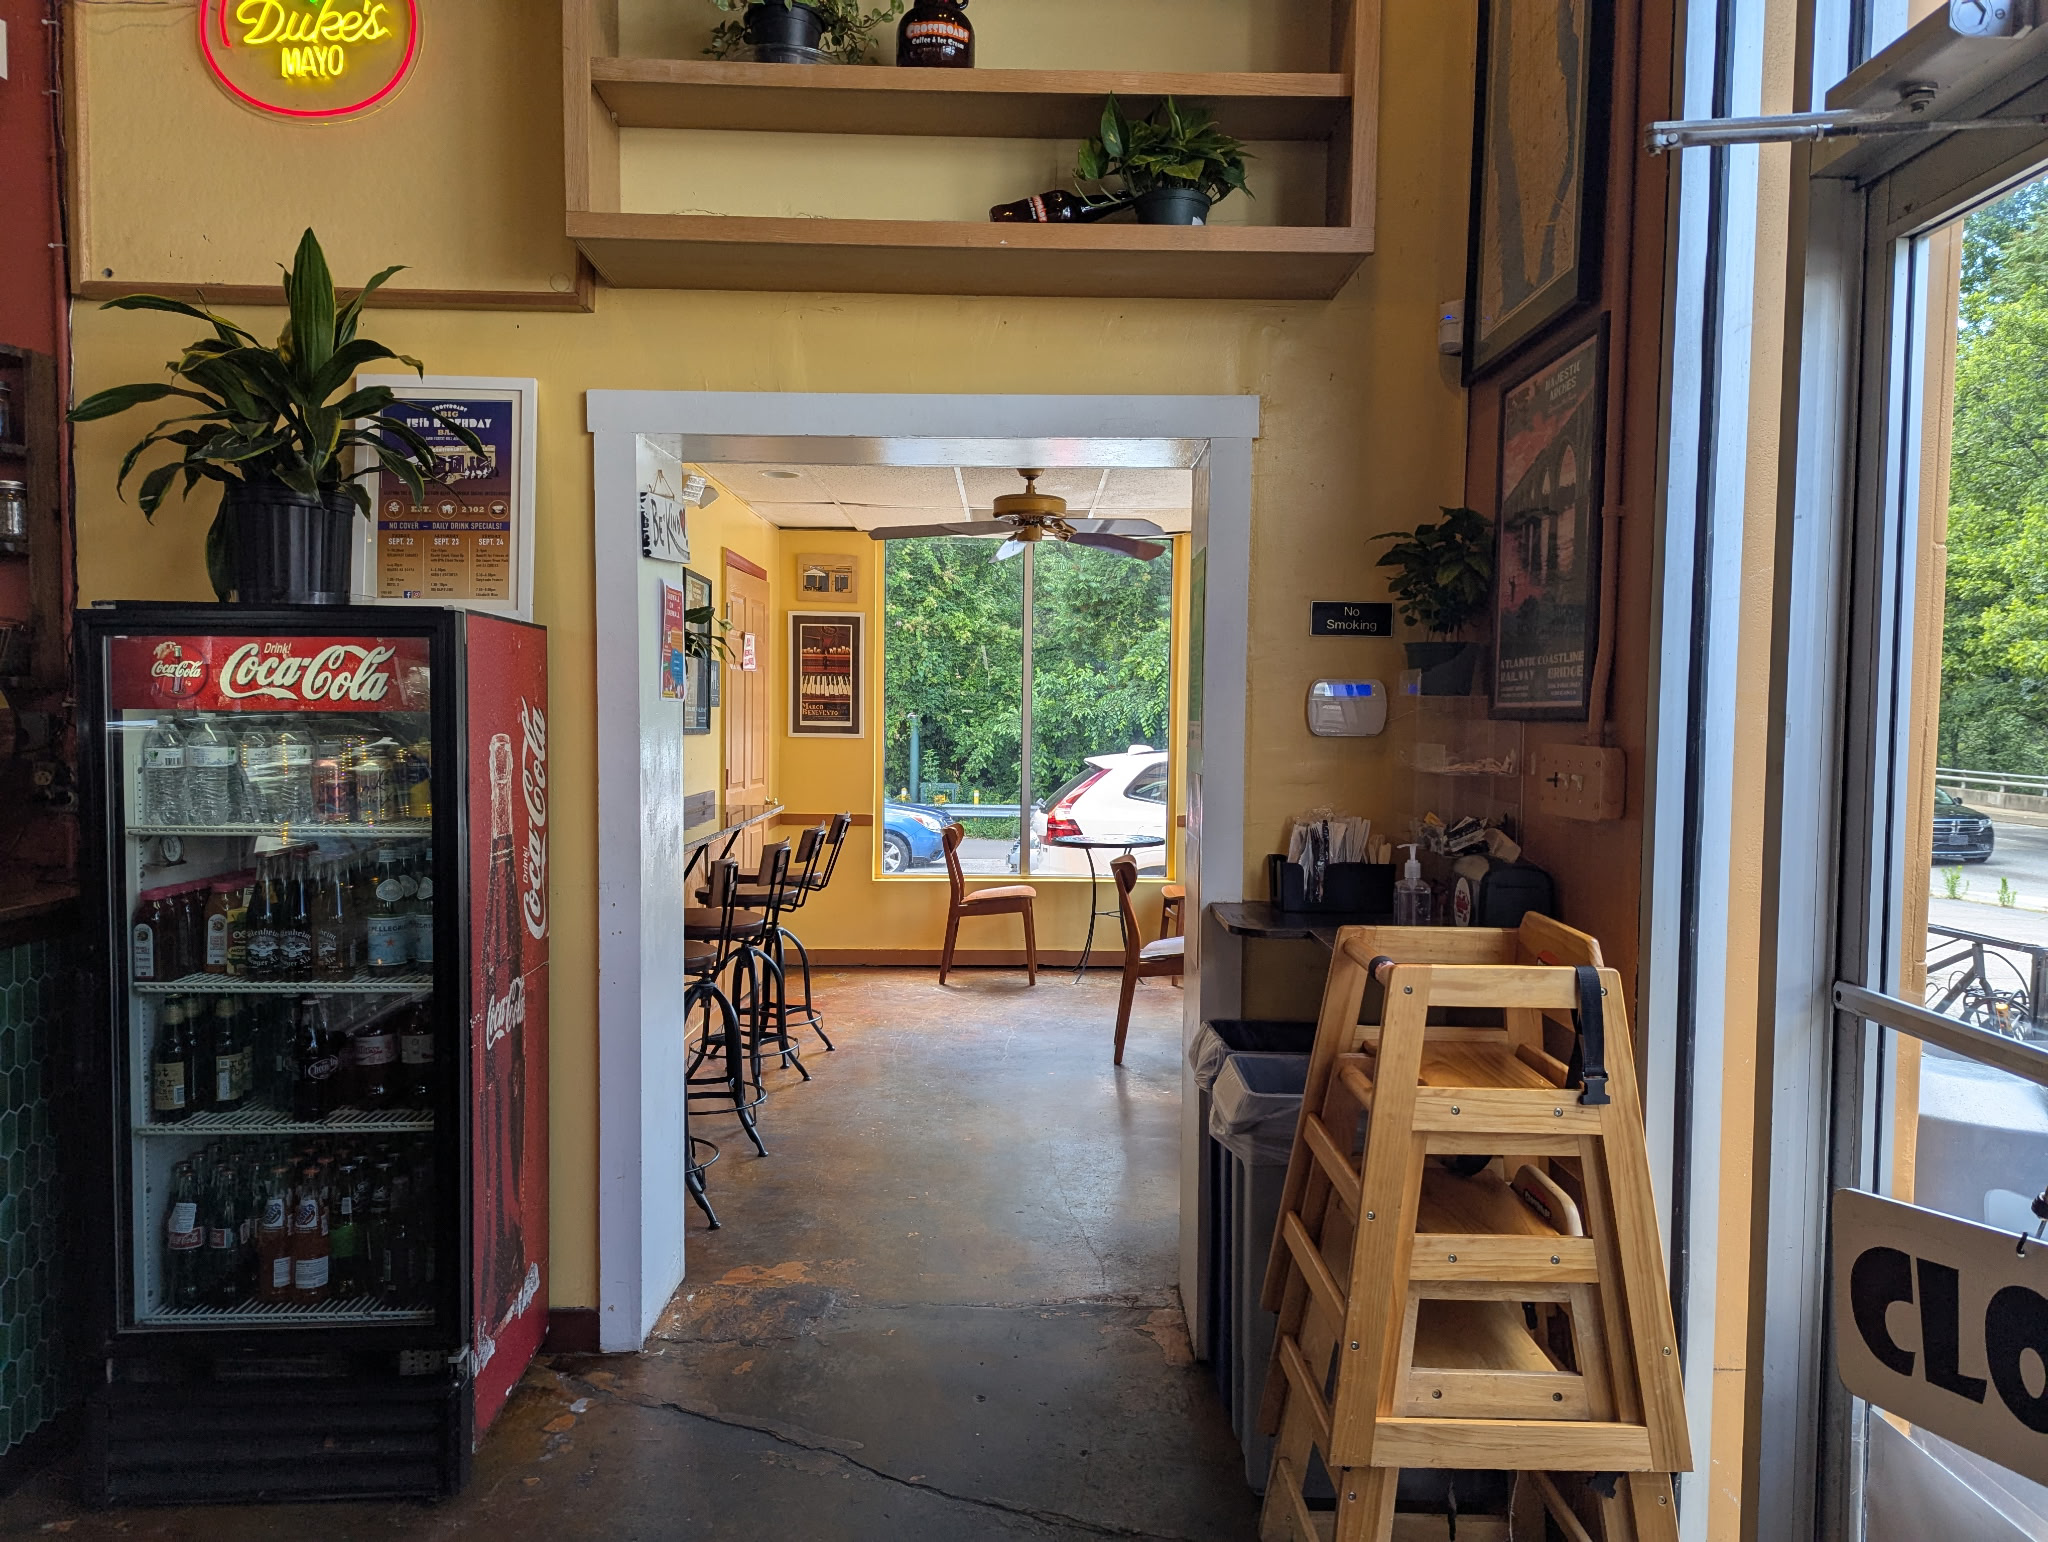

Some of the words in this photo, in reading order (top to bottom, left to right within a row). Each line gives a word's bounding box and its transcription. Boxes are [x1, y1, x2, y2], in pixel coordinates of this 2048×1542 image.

[237, 0, 392, 44] Duke's
[907, 23, 969, 41] CROSSROADS
[912, 37, 930, 45] Coffee
[948, 39, 964, 50] Cream
[281, 45, 344, 78] MAYO
[406, 418, 429, 429] 15th
[389, 522, 398, 530] NO
[399, 522, 419, 530] COVER
[432, 522, 449, 530] DAILY
[450, 522, 469, 530] DRINK
[471, 522, 503, 530] SPECIALS!
[388, 538, 404, 546] SEPT.
[406, 538, 414, 546] 22
[433, 538, 450, 546] SEPT.
[478, 538, 495, 546] SEPT.
[1344, 606, 1360, 617] No
[1326, 619, 1377, 632] Smoking
[264, 642, 292, 654] Drink!
[1537, 650, 1585, 666] COASTLINE
[151, 660, 203, 678] Coca-Cola
[219, 643, 396, 701] Coca-Cola
[1547, 664, 1584, 679] BRIDGE
[520, 694, 548, 940] Coca-Cola
[521, 845, 532, 884] Drink!
